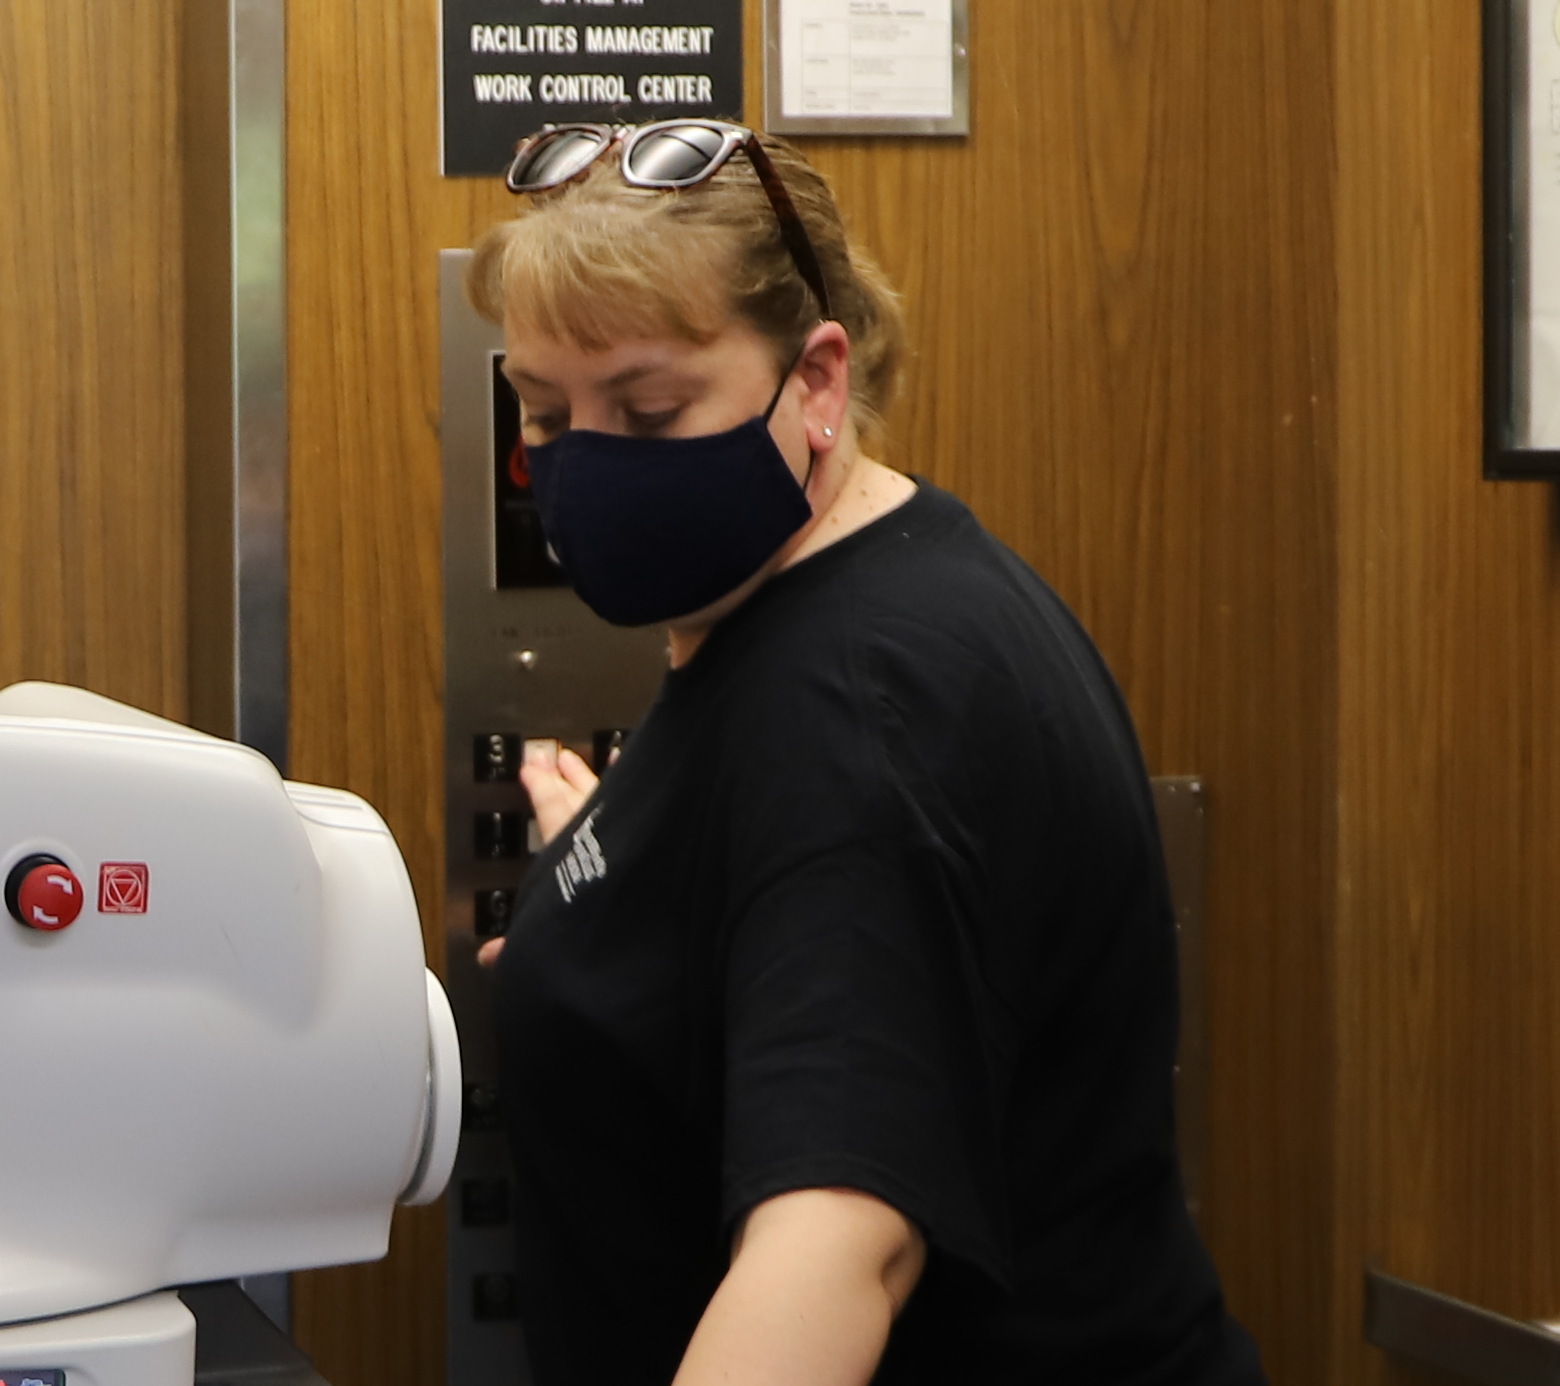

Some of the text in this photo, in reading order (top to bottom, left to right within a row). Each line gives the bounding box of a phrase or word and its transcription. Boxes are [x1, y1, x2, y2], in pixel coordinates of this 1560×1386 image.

[470, 24, 714, 54] FACILITIES MANAGEMENT
[473, 73, 713, 103] WORK CONTROL CENTER
[488, 734, 503, 763] 3
